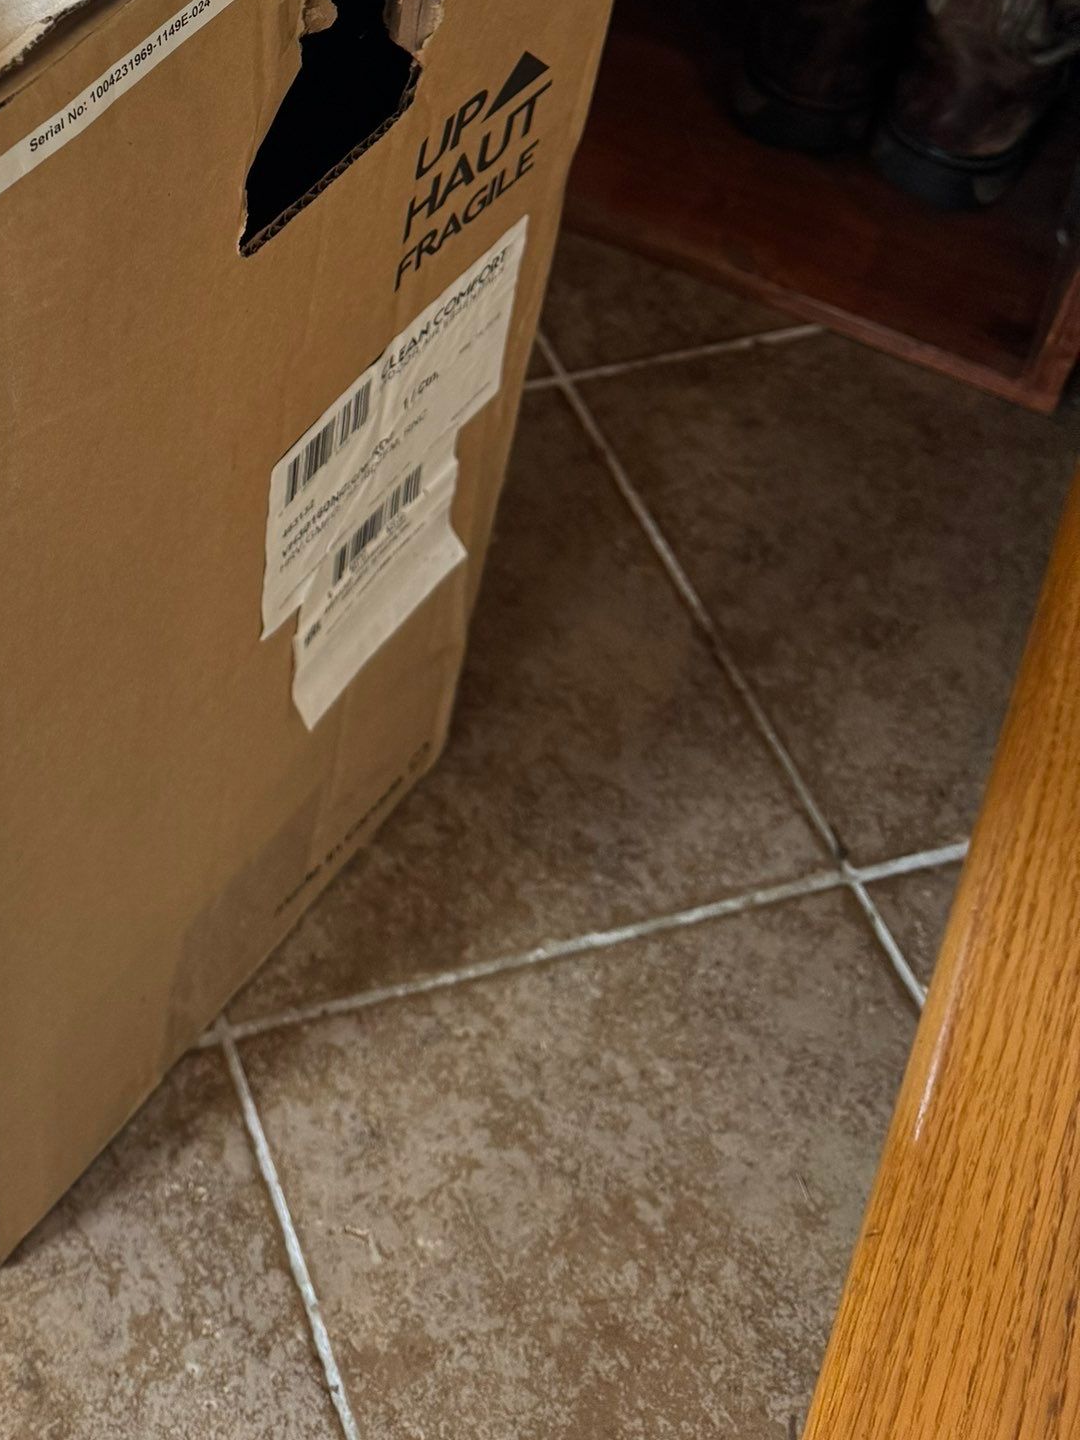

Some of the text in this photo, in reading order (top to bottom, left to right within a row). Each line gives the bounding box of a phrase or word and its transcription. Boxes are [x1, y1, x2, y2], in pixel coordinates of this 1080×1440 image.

[29, 118, 65, 152] Serial
[68, 101, 88, 124] No:
[403, 79, 553, 244] HAUT
[416, 89, 488, 180] UP
[394, 139, 540, 293] FRAGILE
